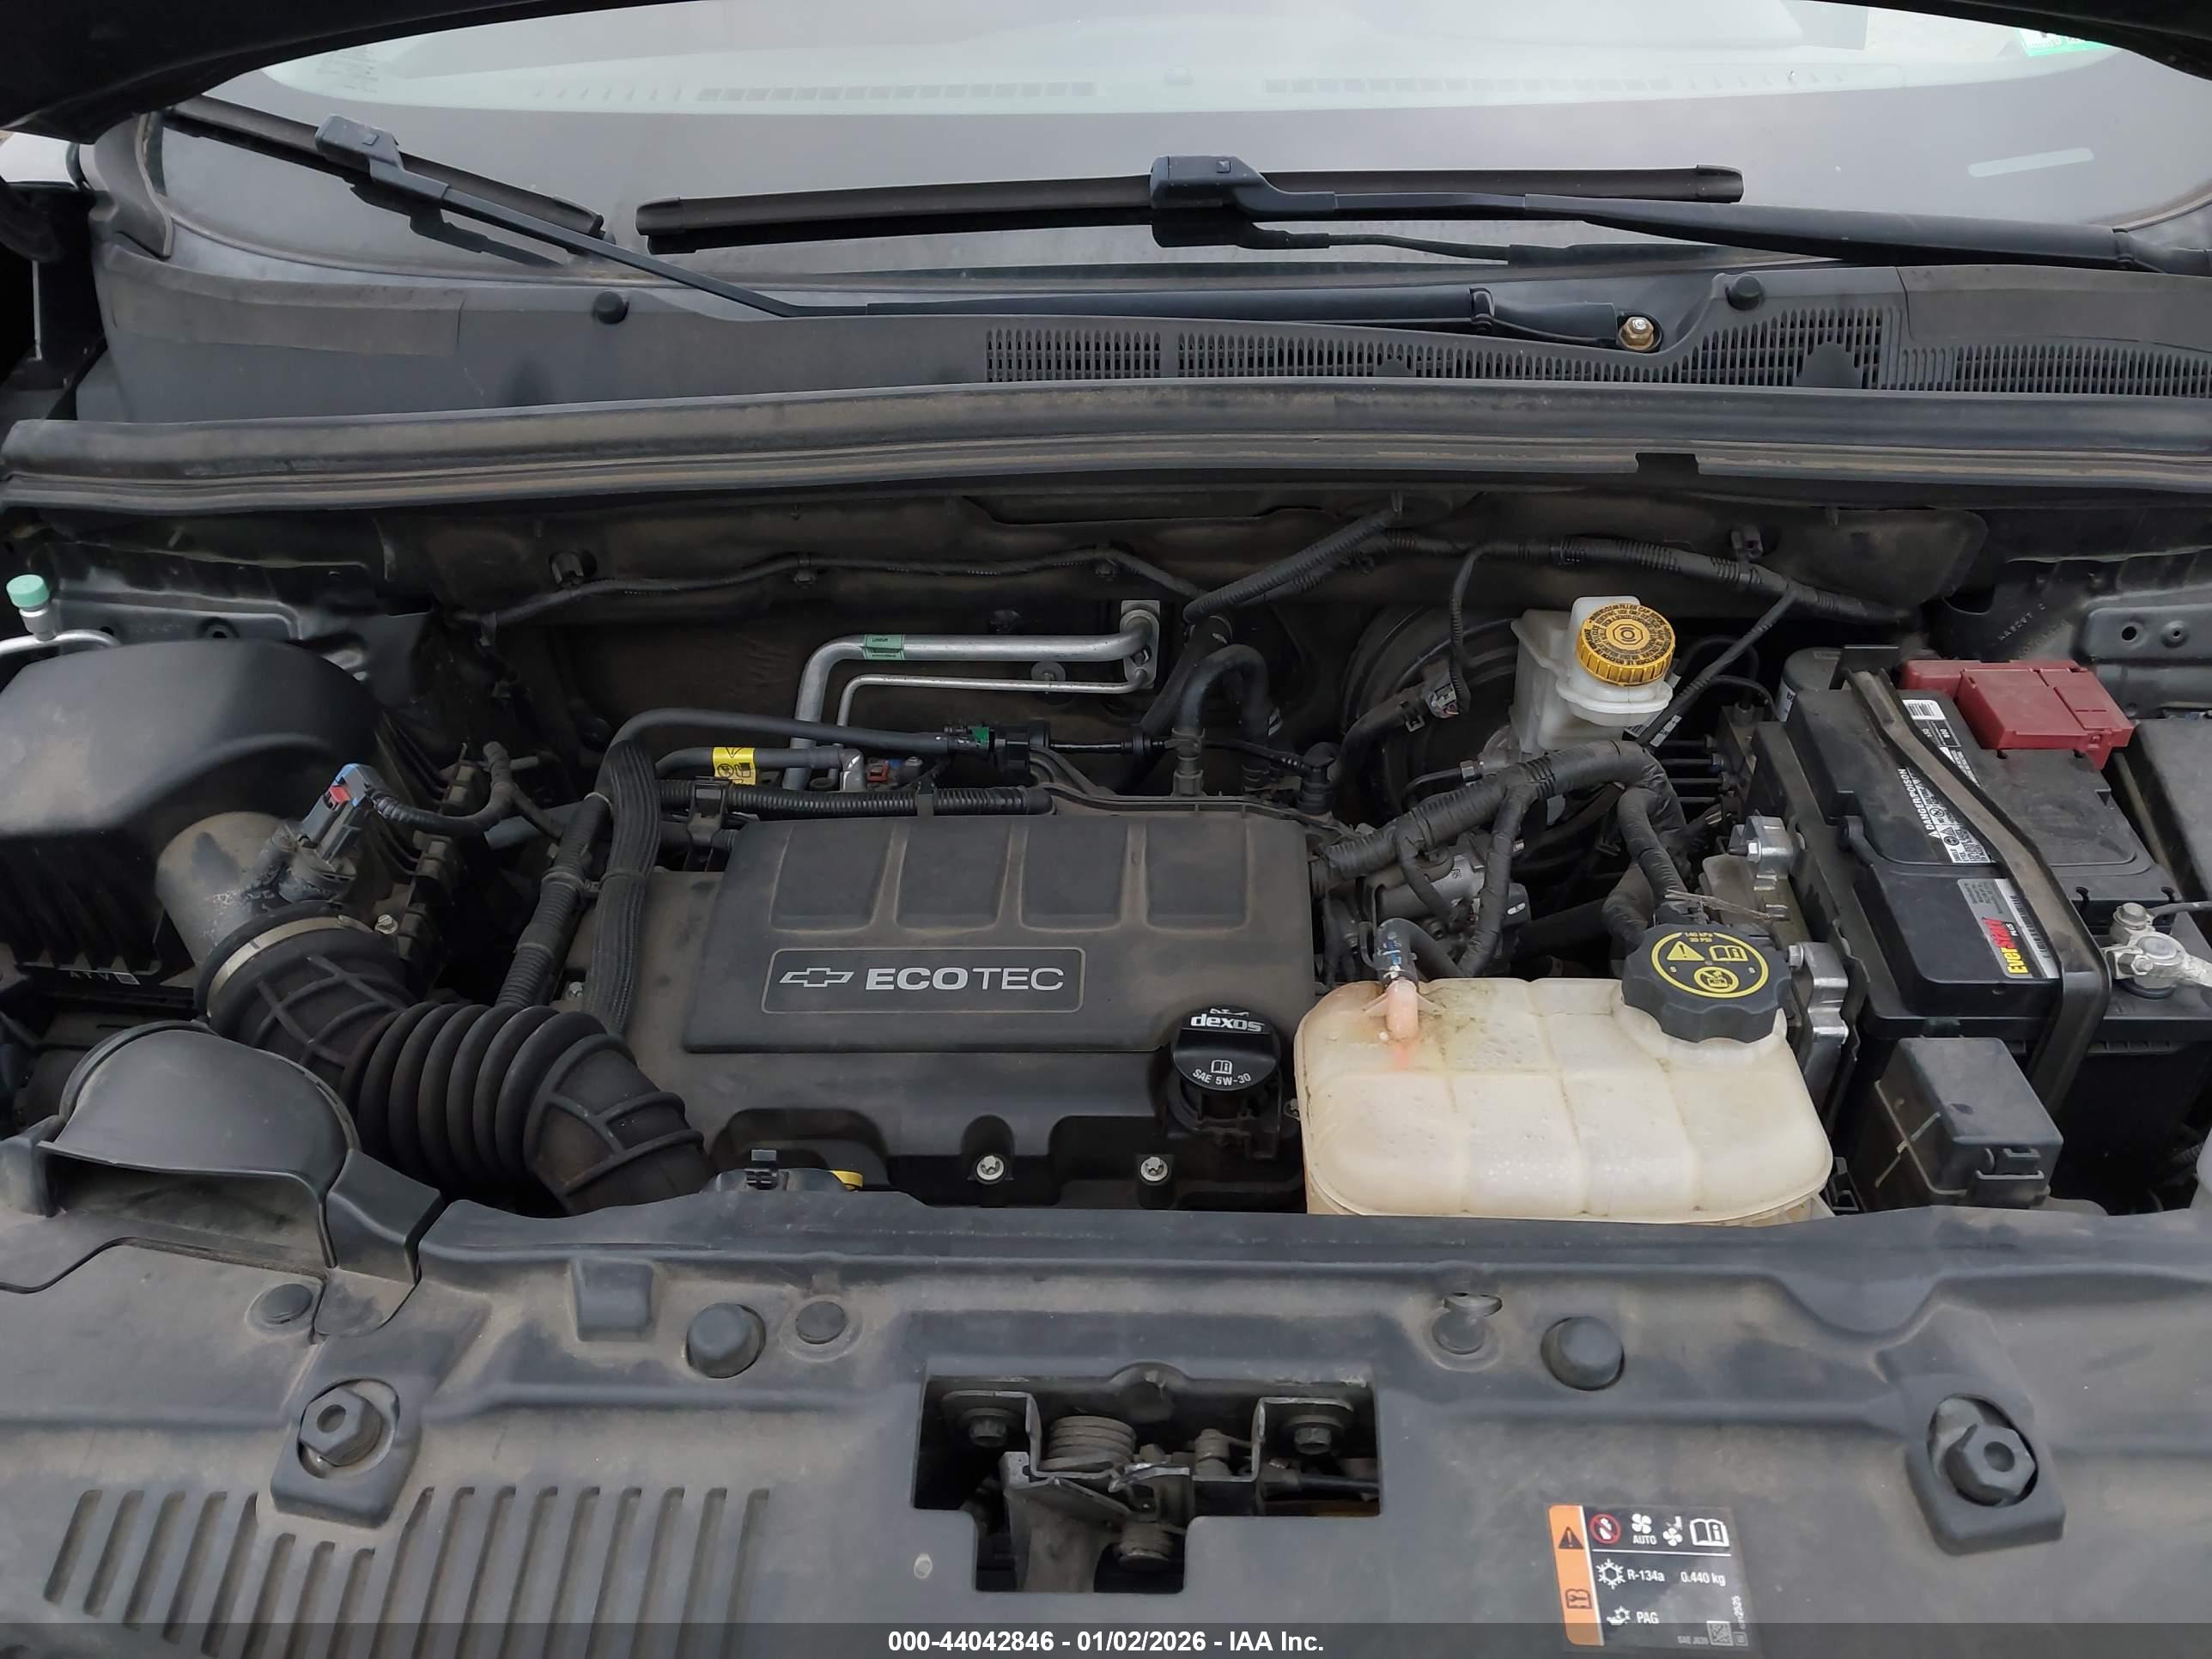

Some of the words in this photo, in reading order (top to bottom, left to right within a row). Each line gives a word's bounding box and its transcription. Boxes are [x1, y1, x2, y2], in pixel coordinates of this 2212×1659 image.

[866, 967, 1064, 990] ECOTEC
[1190, 1013, 1265, 1032] dexos
[1192, 1068, 1212, 1084] SAE
[1215, 1073, 1251, 1086] 5W-30
[1632, 1534, 1657, 1546] AUTO
[1627, 1569, 1665, 1583] R-134a
[1680, 1571, 1710, 1584] 0.440
[1711, 1571, 1726, 1587] kg
[1636, 1611, 1659, 1625] PAG
